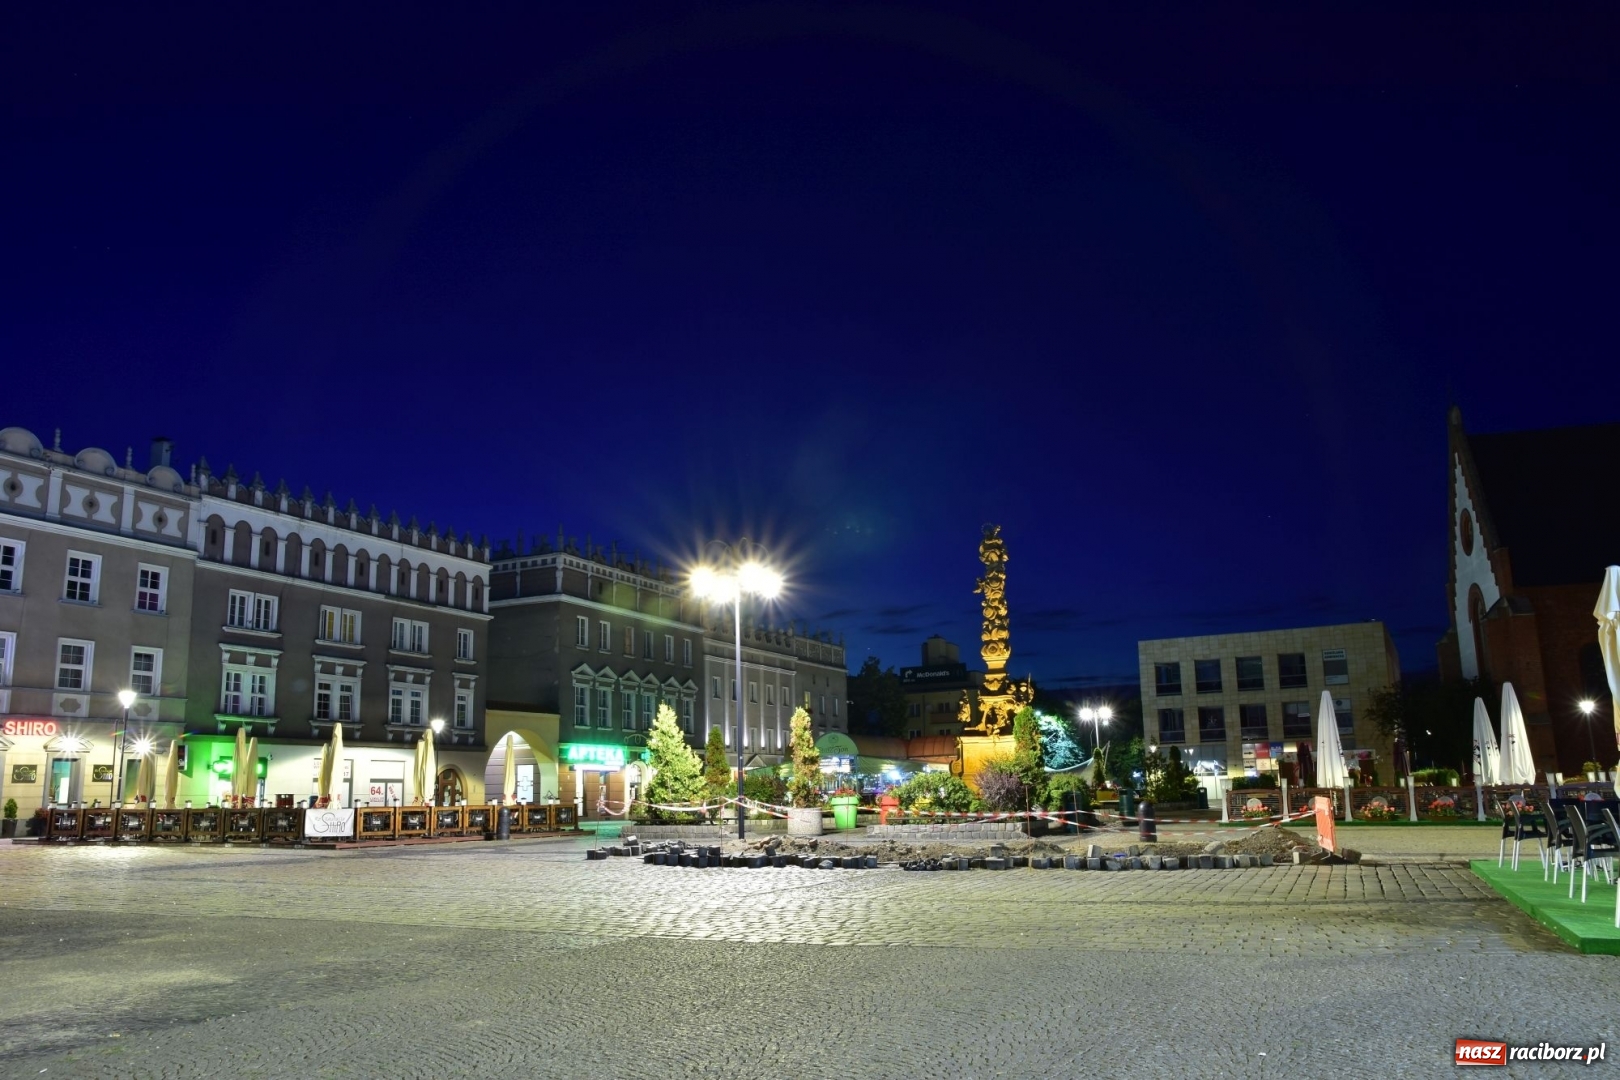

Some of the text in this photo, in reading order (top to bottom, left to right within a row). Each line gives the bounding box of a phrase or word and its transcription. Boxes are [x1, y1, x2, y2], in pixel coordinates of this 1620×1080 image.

[916, 670, 950, 678] McDonald's
[4, 720, 57, 736] SHIRO
[567, 745, 626, 761] APTEKA
